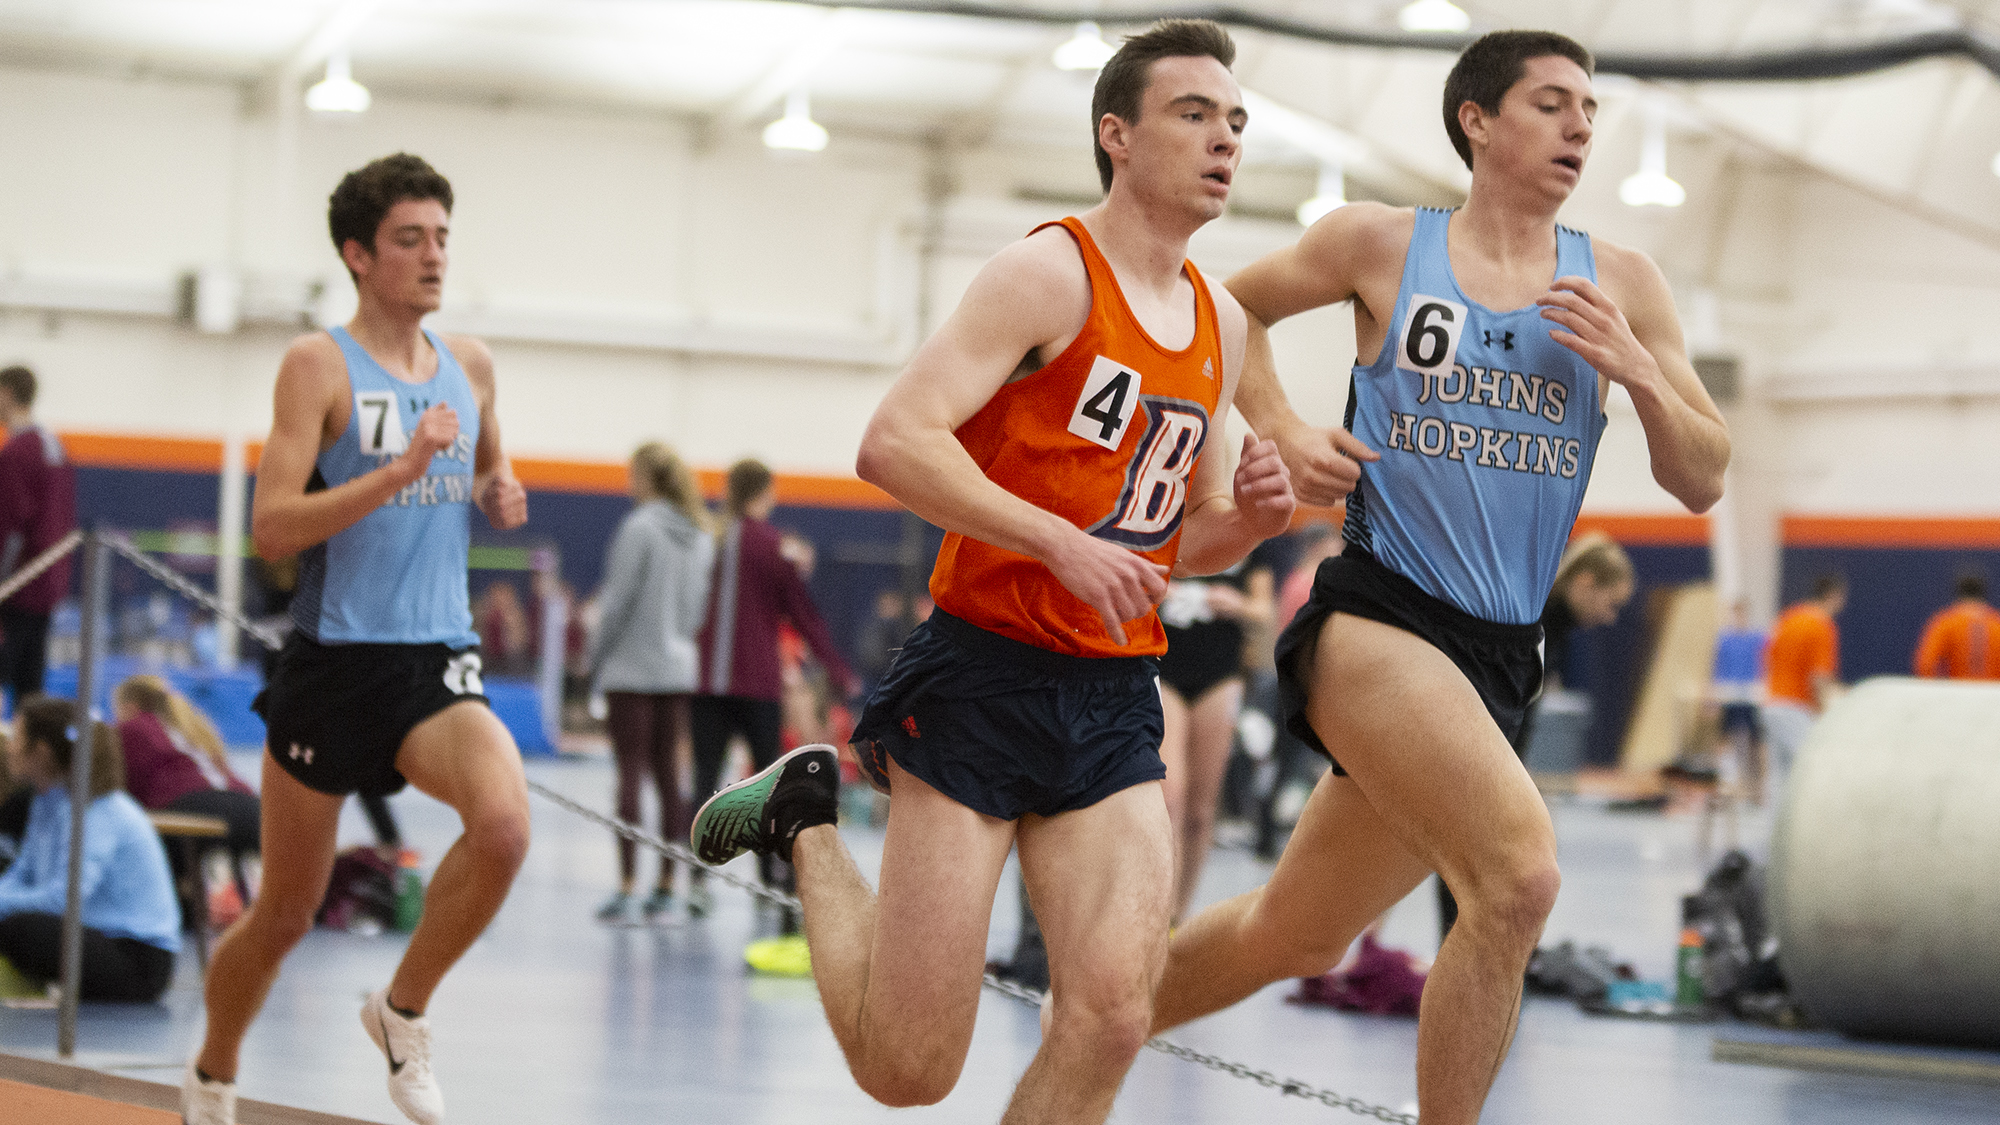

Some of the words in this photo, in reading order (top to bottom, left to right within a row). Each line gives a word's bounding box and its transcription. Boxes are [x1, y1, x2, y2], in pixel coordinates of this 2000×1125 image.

[1406, 302, 1455, 369] 6
[361, 399, 389, 449] 7
[1080, 370, 1133, 443] 4
[1416, 363, 1569, 426] JOHNS
[1107, 402, 1206, 540] B
[1386, 410, 1581, 479] HOPKINS
